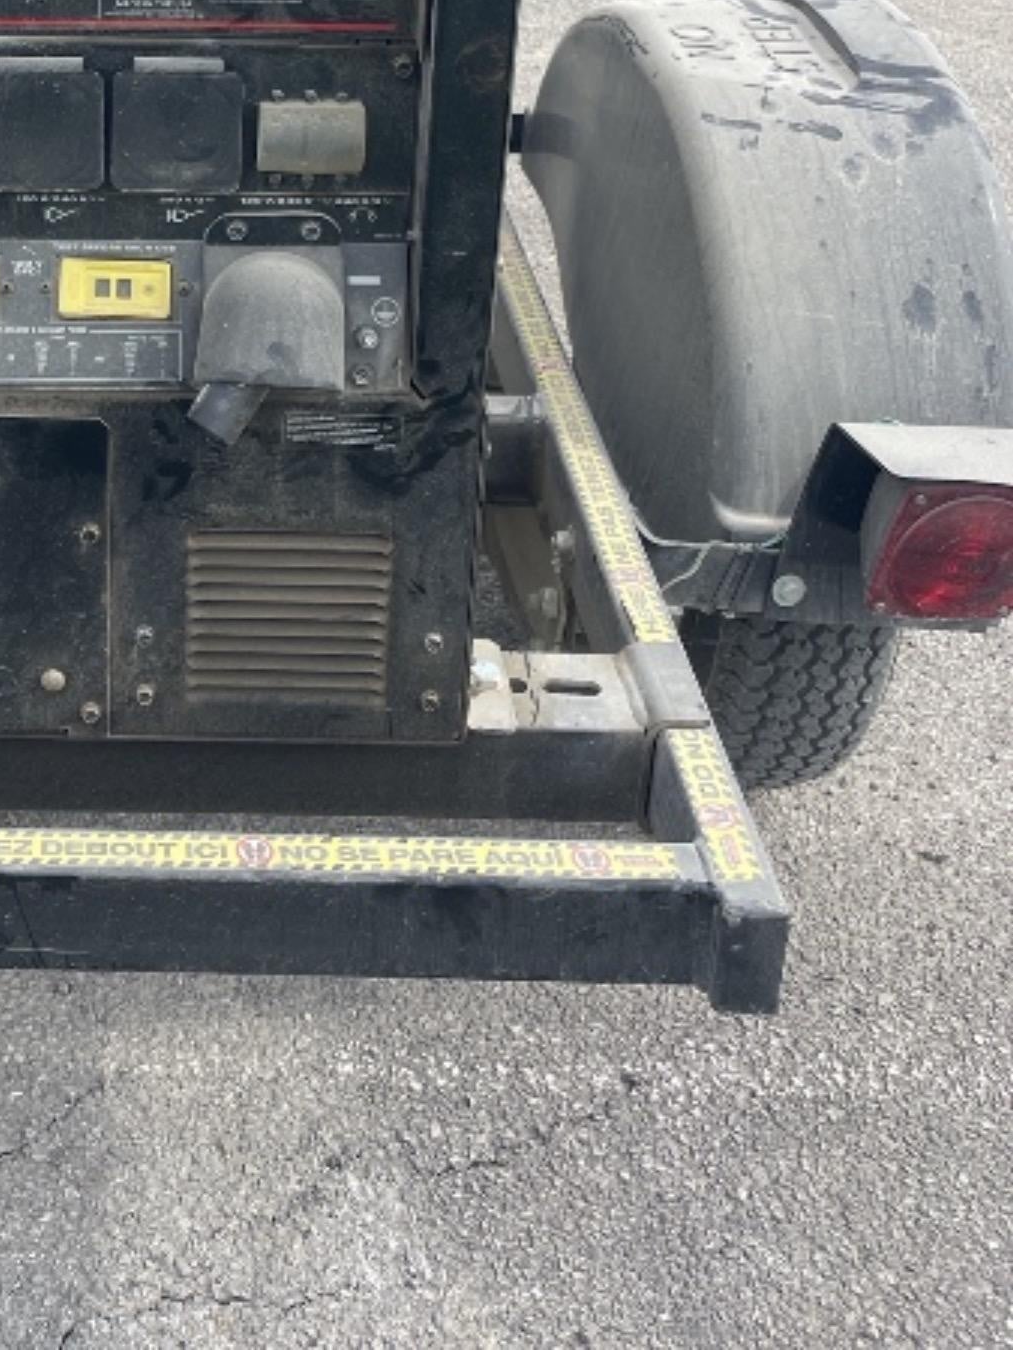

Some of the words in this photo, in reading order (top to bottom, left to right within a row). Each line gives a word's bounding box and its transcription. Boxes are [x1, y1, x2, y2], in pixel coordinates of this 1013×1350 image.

[39, 839, 183, 859] DEBOUT
[184, 841, 229, 860] ICI
[278, 843, 330, 861] NO
[337, 845, 381, 863] SE
[387, 846, 479, 866] PARE
